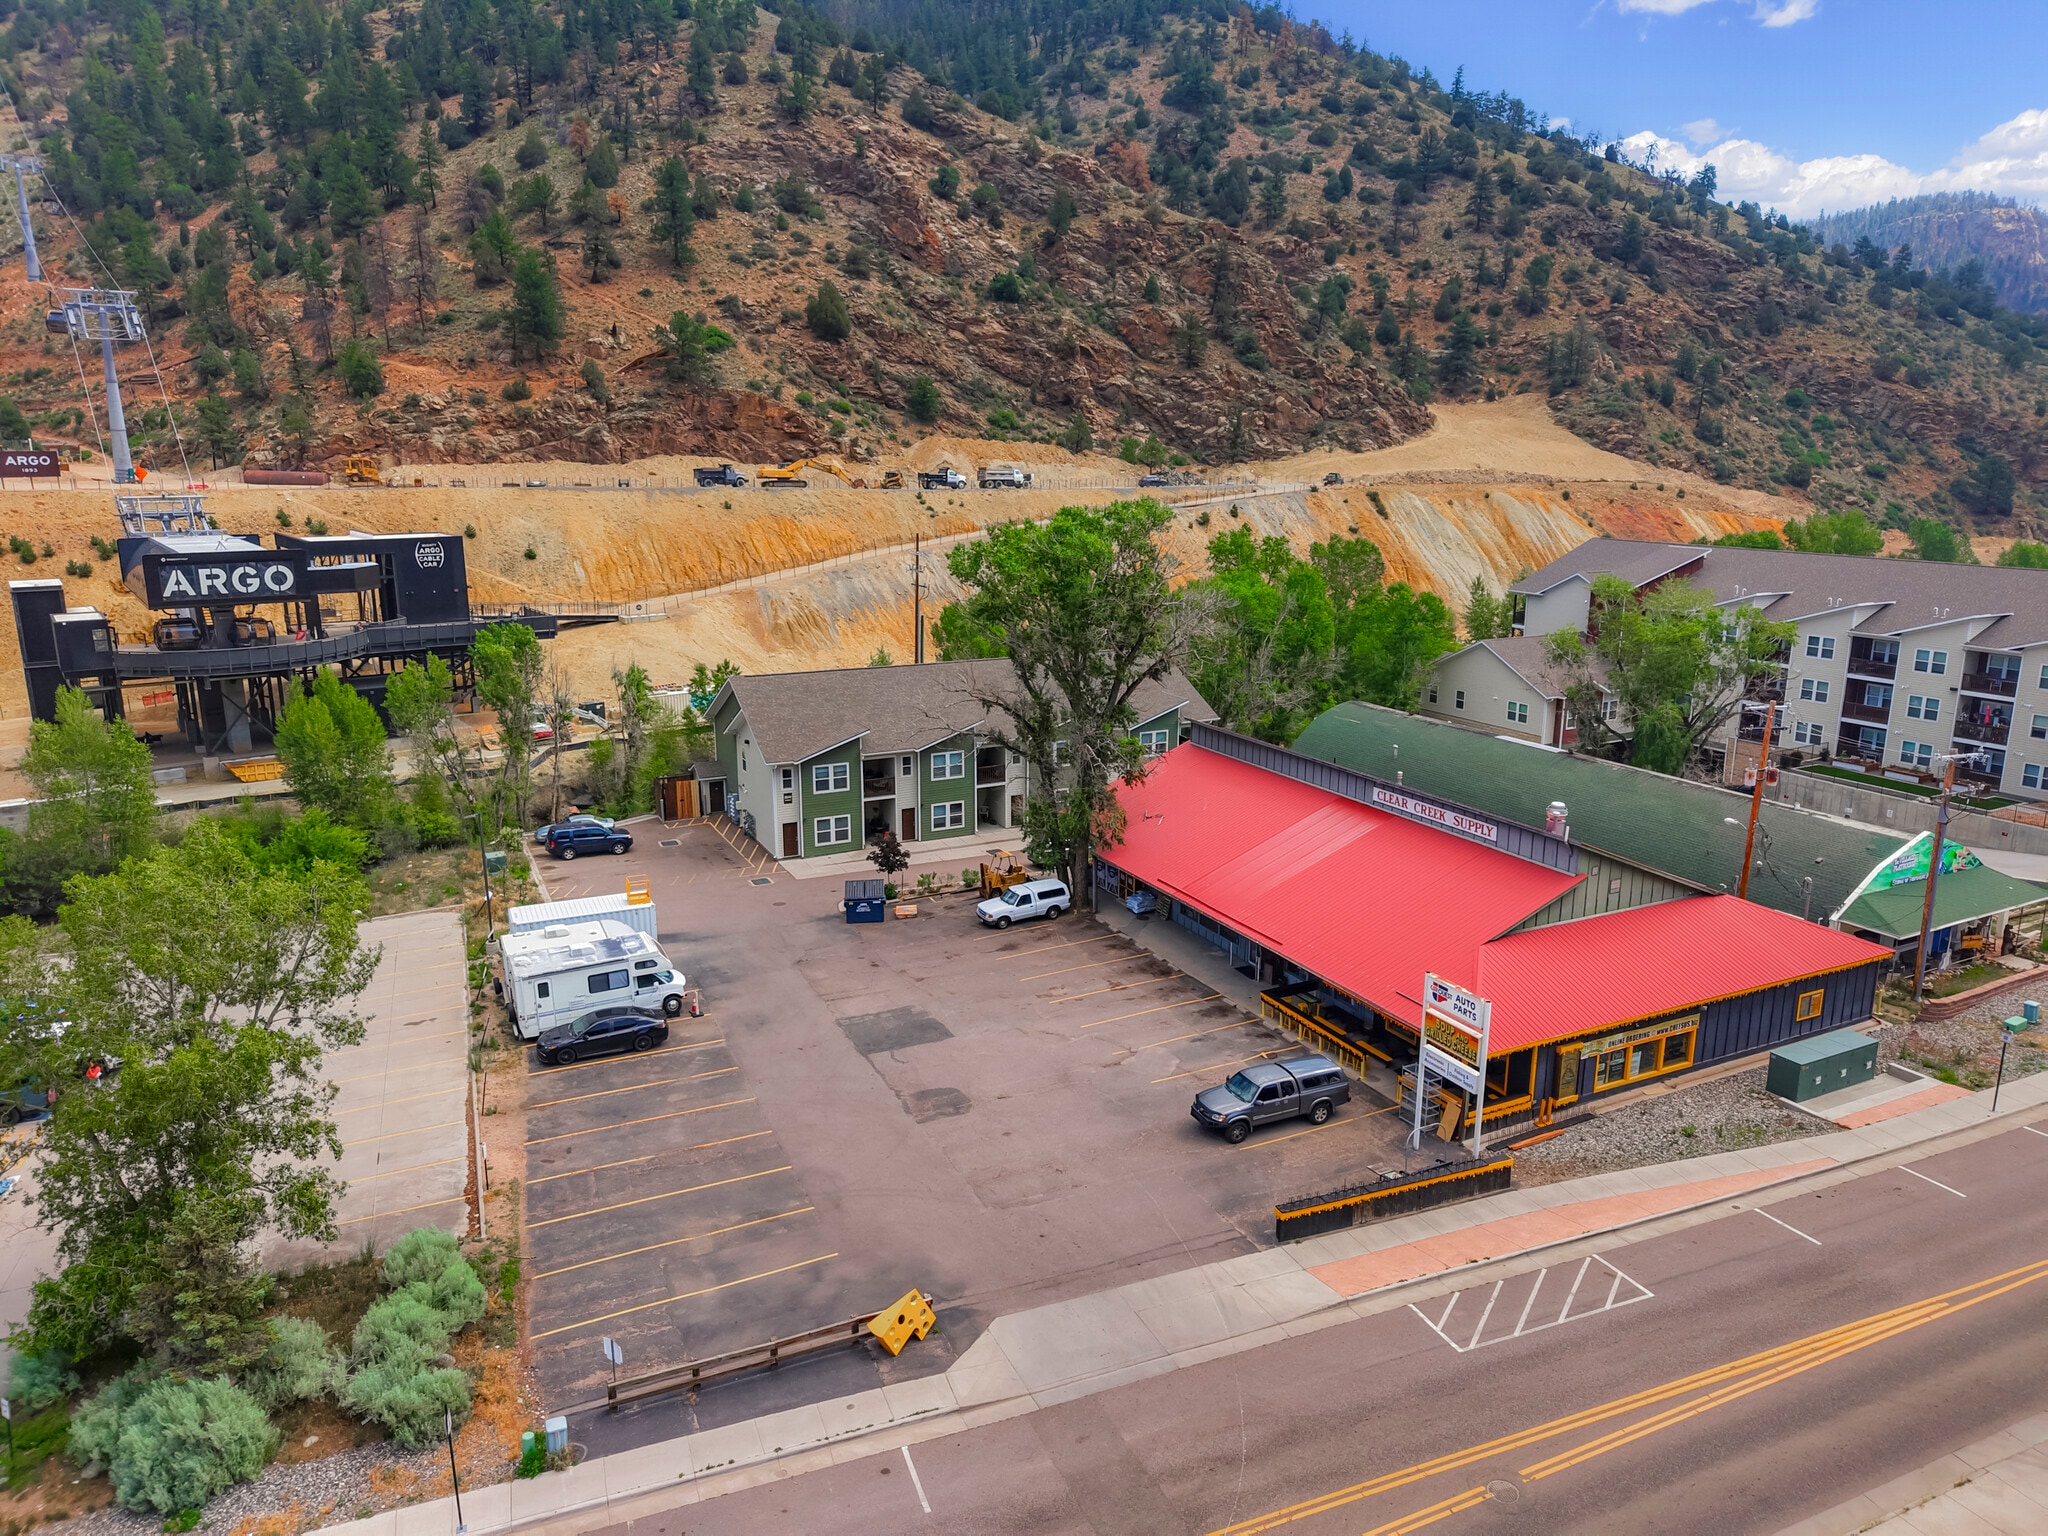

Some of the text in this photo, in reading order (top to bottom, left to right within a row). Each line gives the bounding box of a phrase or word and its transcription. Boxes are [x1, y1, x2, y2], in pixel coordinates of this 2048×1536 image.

[5, 455, 50, 466] ARGO
[163, 565, 294, 597] ARGO
[1377, 790, 1493, 837] CLEAR CREEK SUPPLY
[1453, 1003, 1476, 1021] PARTS
[1456, 995, 1476, 1010] AUTO
[1436, 1018, 1468, 1044] SOUP AND
[1608, 1036, 1625, 1048] ONLINE
[1626, 1031, 1650, 1042] ORDERING
[1425, 1026, 1477, 1060] GRILLED CHEESE
